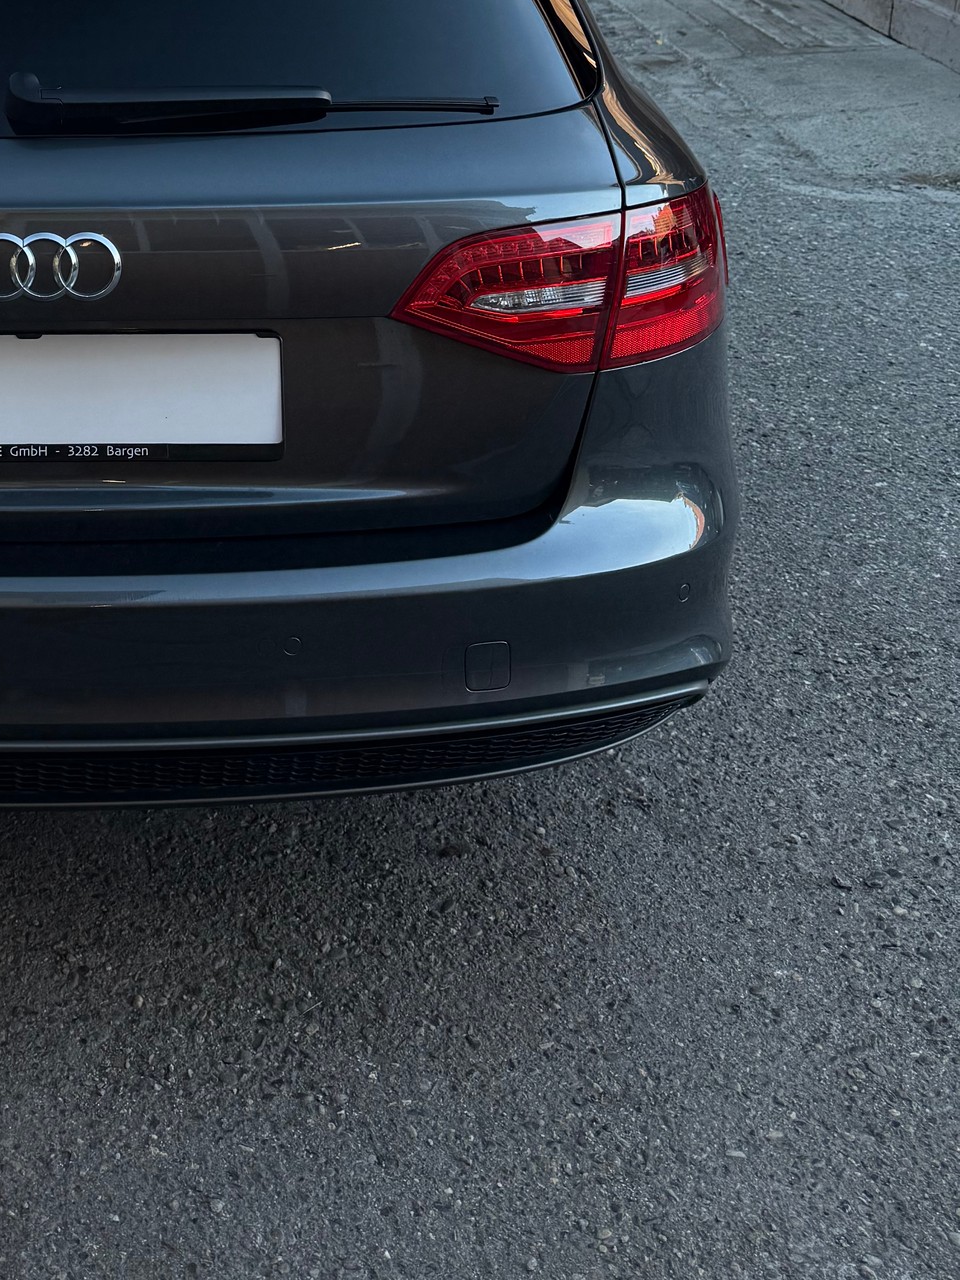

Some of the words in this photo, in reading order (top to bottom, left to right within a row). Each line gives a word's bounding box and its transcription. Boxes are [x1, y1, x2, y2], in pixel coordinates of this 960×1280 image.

[9, 445, 48, 457] GmbH
[67, 446, 99, 457] 3282
[106, 446, 149, 459] Bargen
